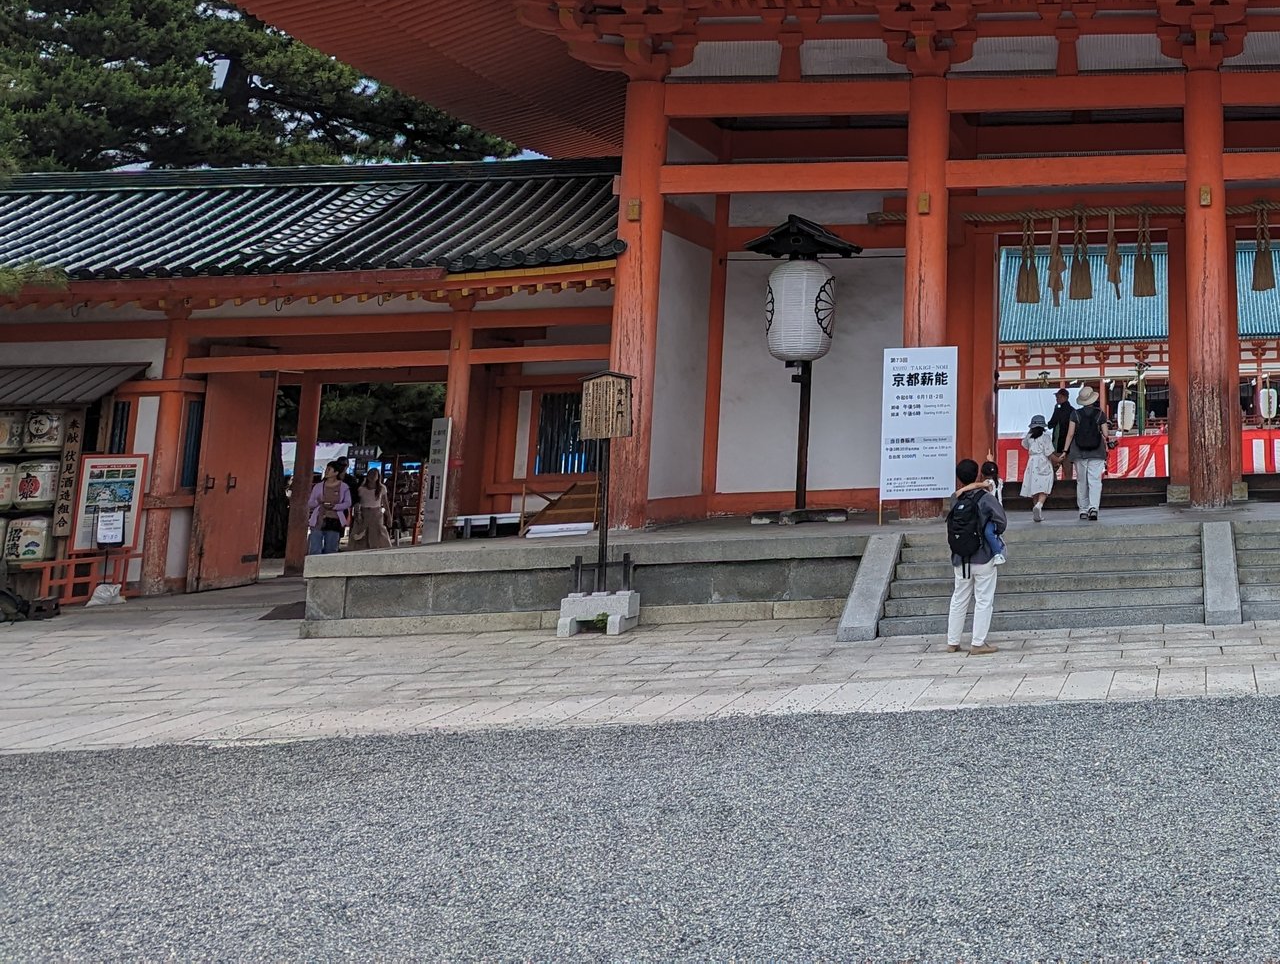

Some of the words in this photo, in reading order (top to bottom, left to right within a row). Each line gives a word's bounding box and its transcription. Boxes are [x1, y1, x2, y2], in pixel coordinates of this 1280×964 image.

[892, 372, 948, 387] 京都薪能
[66, 418, 80, 444] 奉献
[56, 450, 77, 528] 伏見酒造組合
